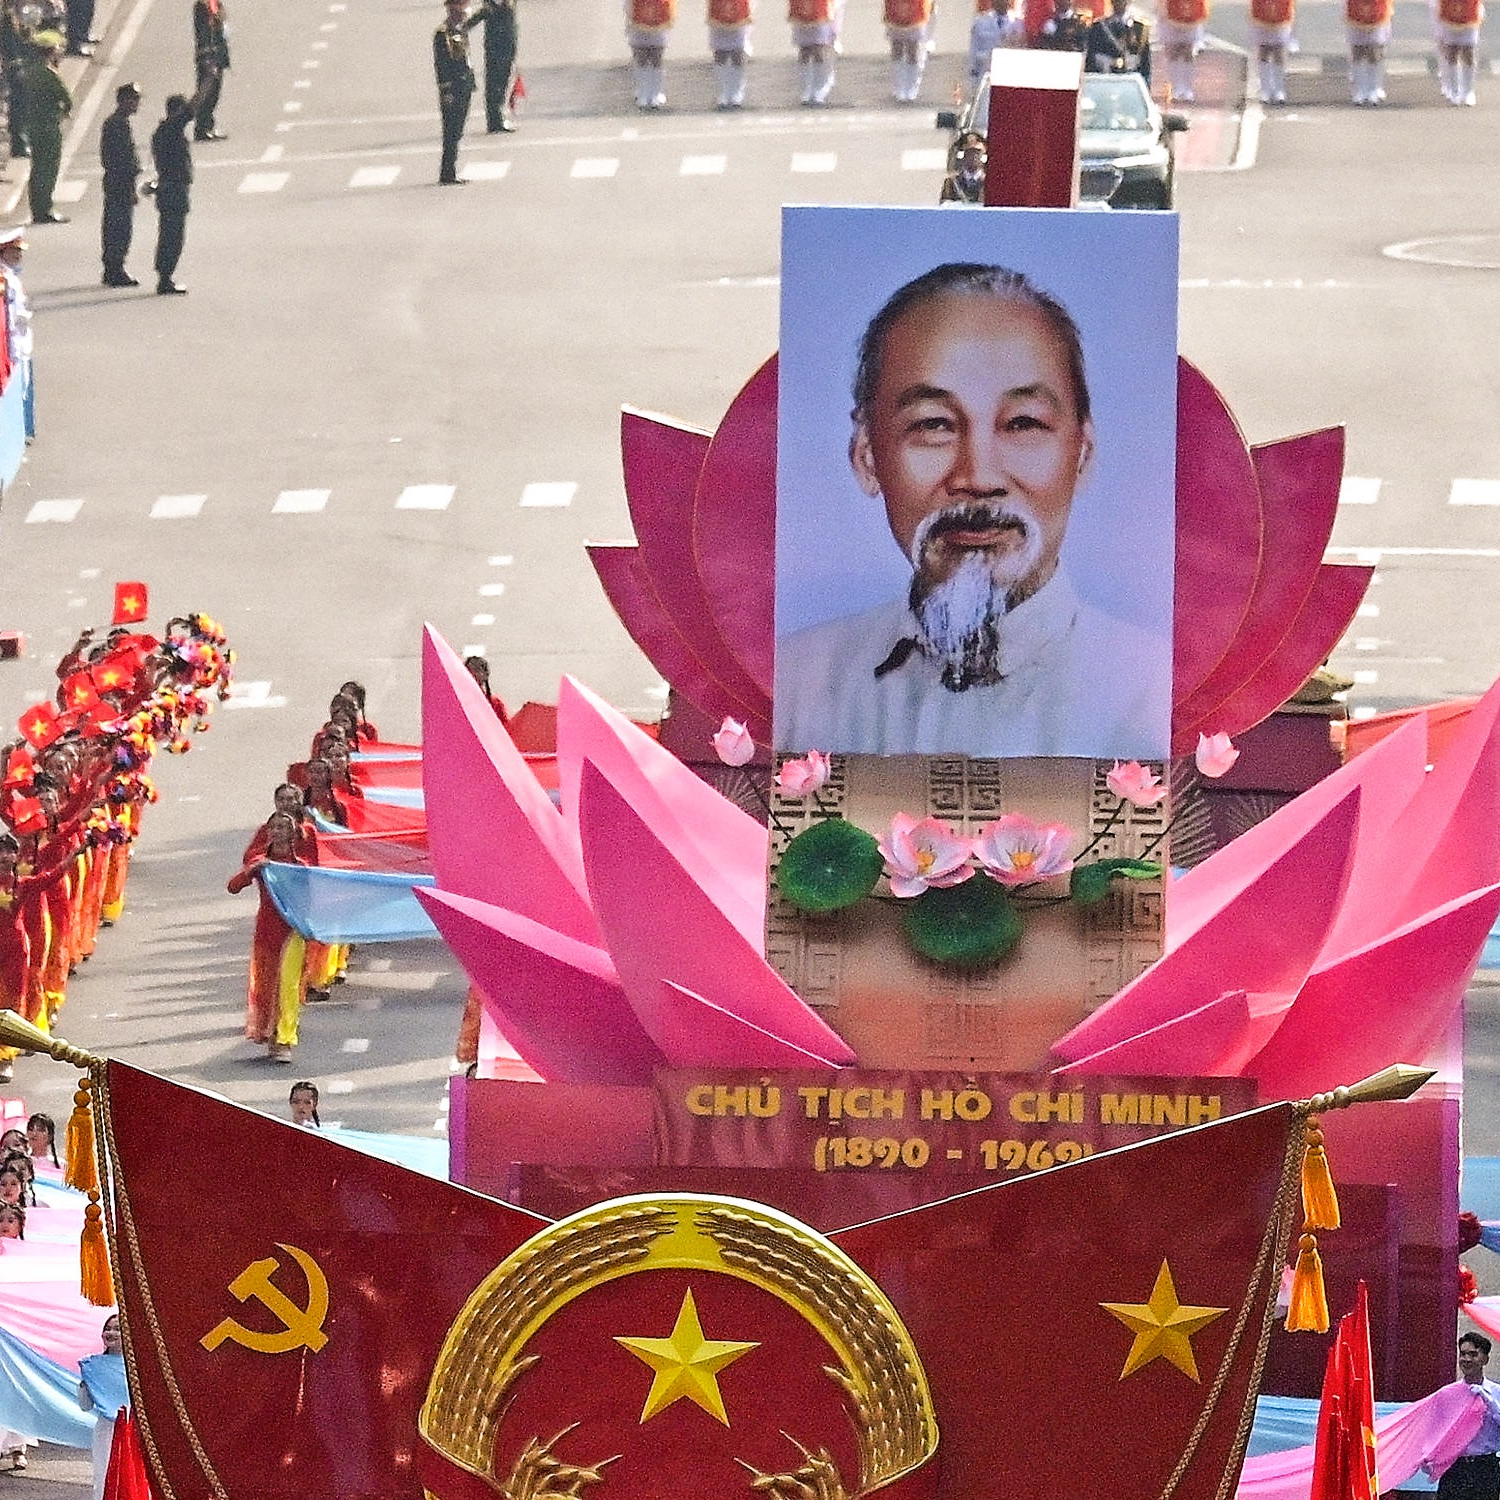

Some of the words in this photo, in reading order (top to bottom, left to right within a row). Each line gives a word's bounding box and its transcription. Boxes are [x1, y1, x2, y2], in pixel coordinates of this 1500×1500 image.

[684, 1076, 780, 1118] CHỦ
[798, 1086, 904, 1126] TỊCH
[920, 1076, 992, 1121] HỒ
[1009, 1084, 1084, 1123] CHÍ
[1100, 1093, 1221, 1125] MINH
[813, 1136, 930, 1172] (1890
[946, 1149, 963, 1160] -
